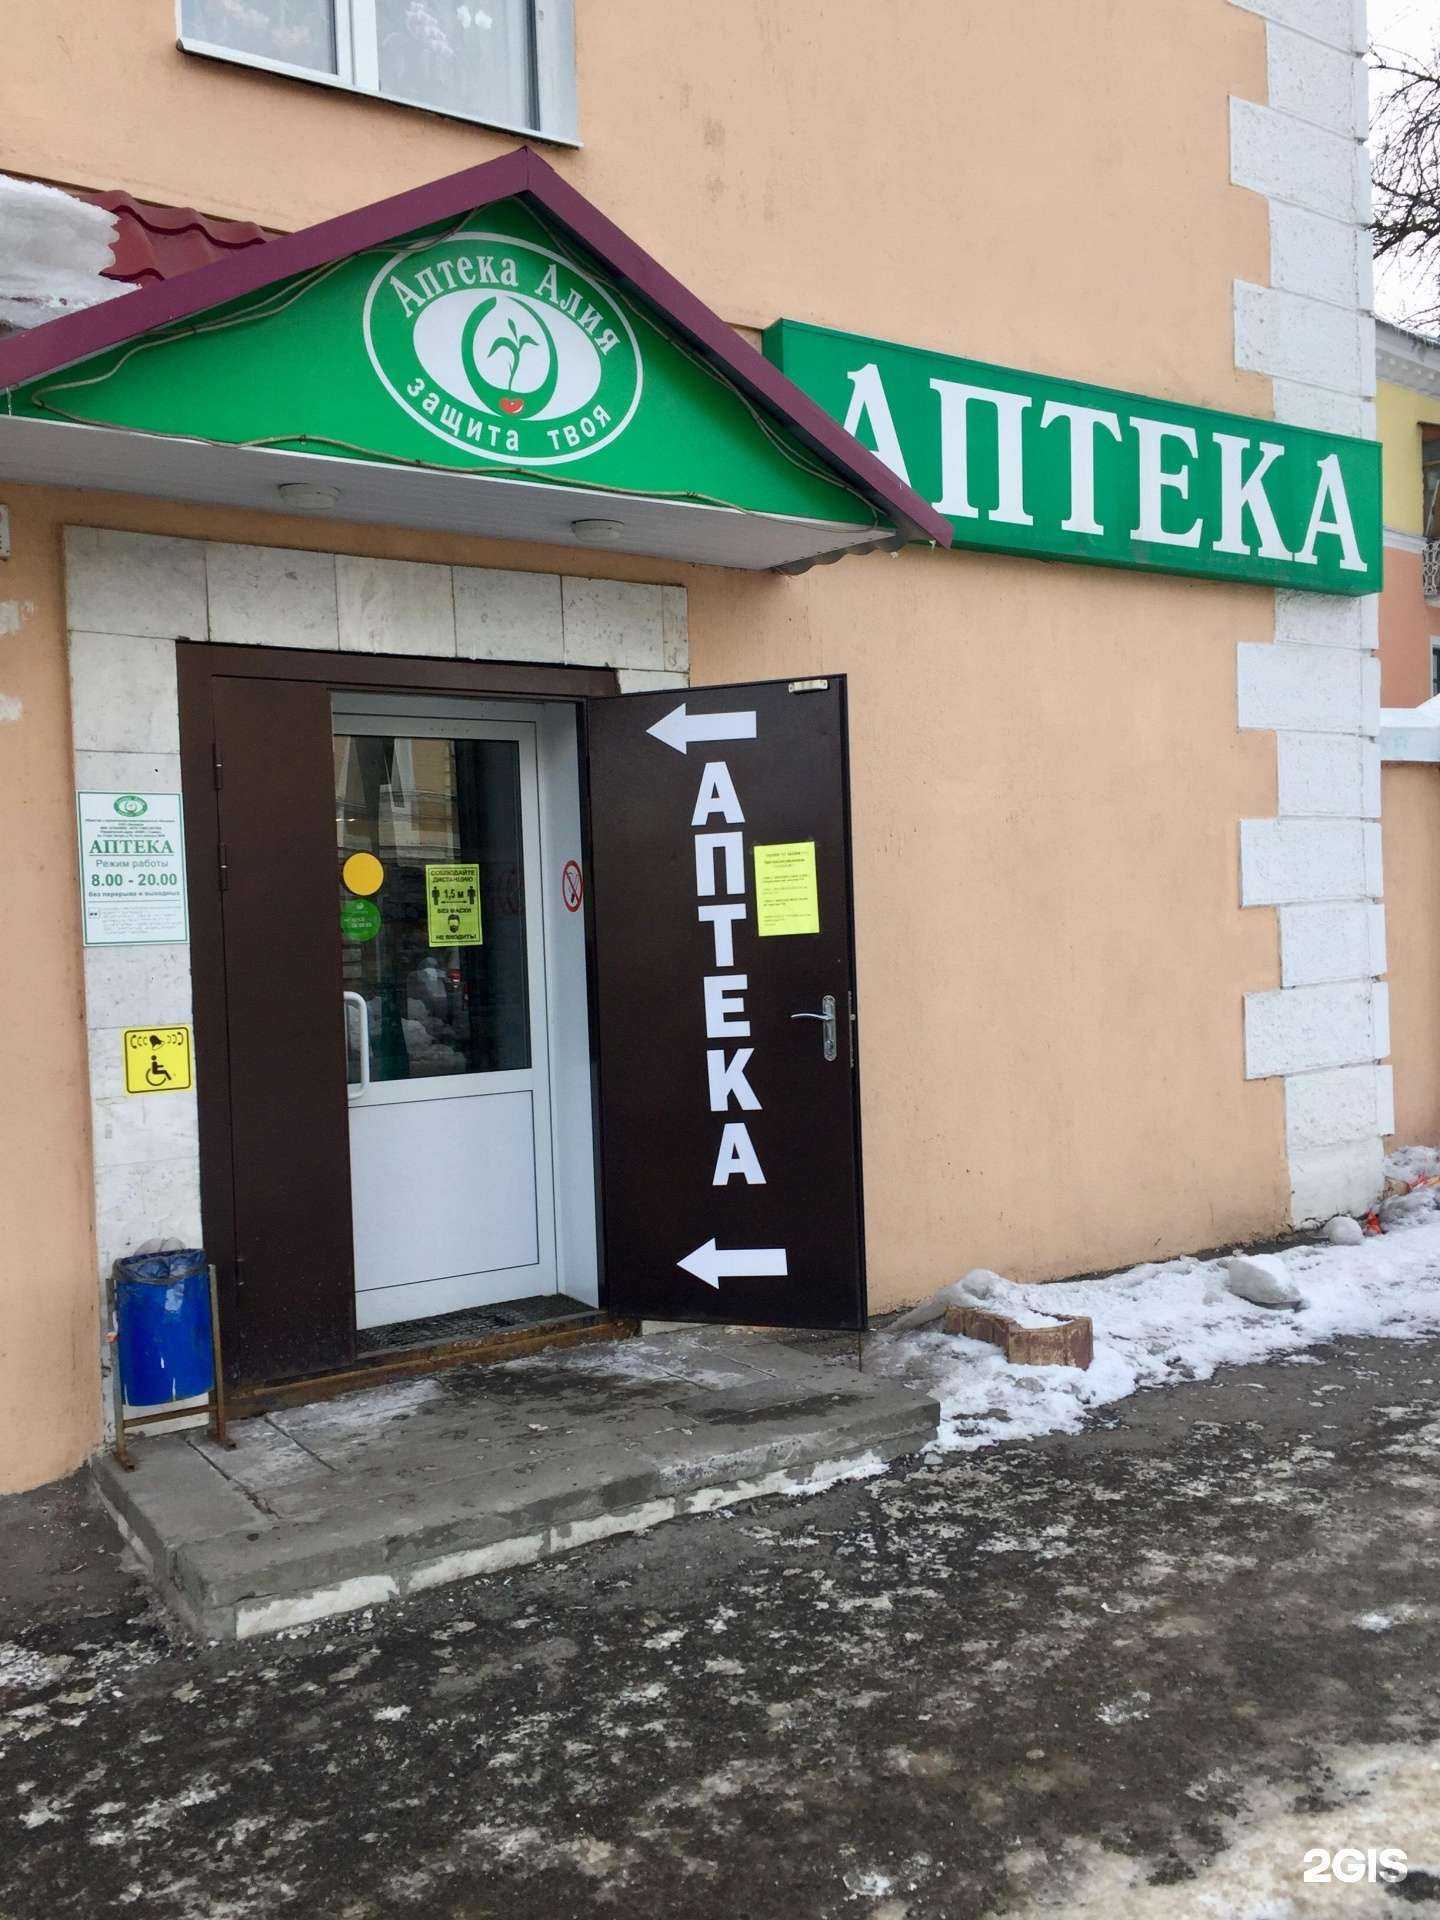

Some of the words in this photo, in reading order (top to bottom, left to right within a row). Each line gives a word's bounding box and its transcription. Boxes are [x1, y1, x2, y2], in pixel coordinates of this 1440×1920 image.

[389, 255, 519, 318] Аптека
[534, 263, 621, 356] Алия
[406, 377, 520, 451] защита
[546, 405, 613, 451] твоя
[842, 362, 1368, 572] АПТЕКА
[89, 840, 174, 854] АПТЕКА
[96, 859, 129, 868] Режим
[132, 859, 169, 869] работы
[91, 874, 123, 887] 8.00
[138, 873, 177, 886] 20.00
[444, 889, 456, 900] 1,5
[691, 761, 767, 1186] АПТЕКА
